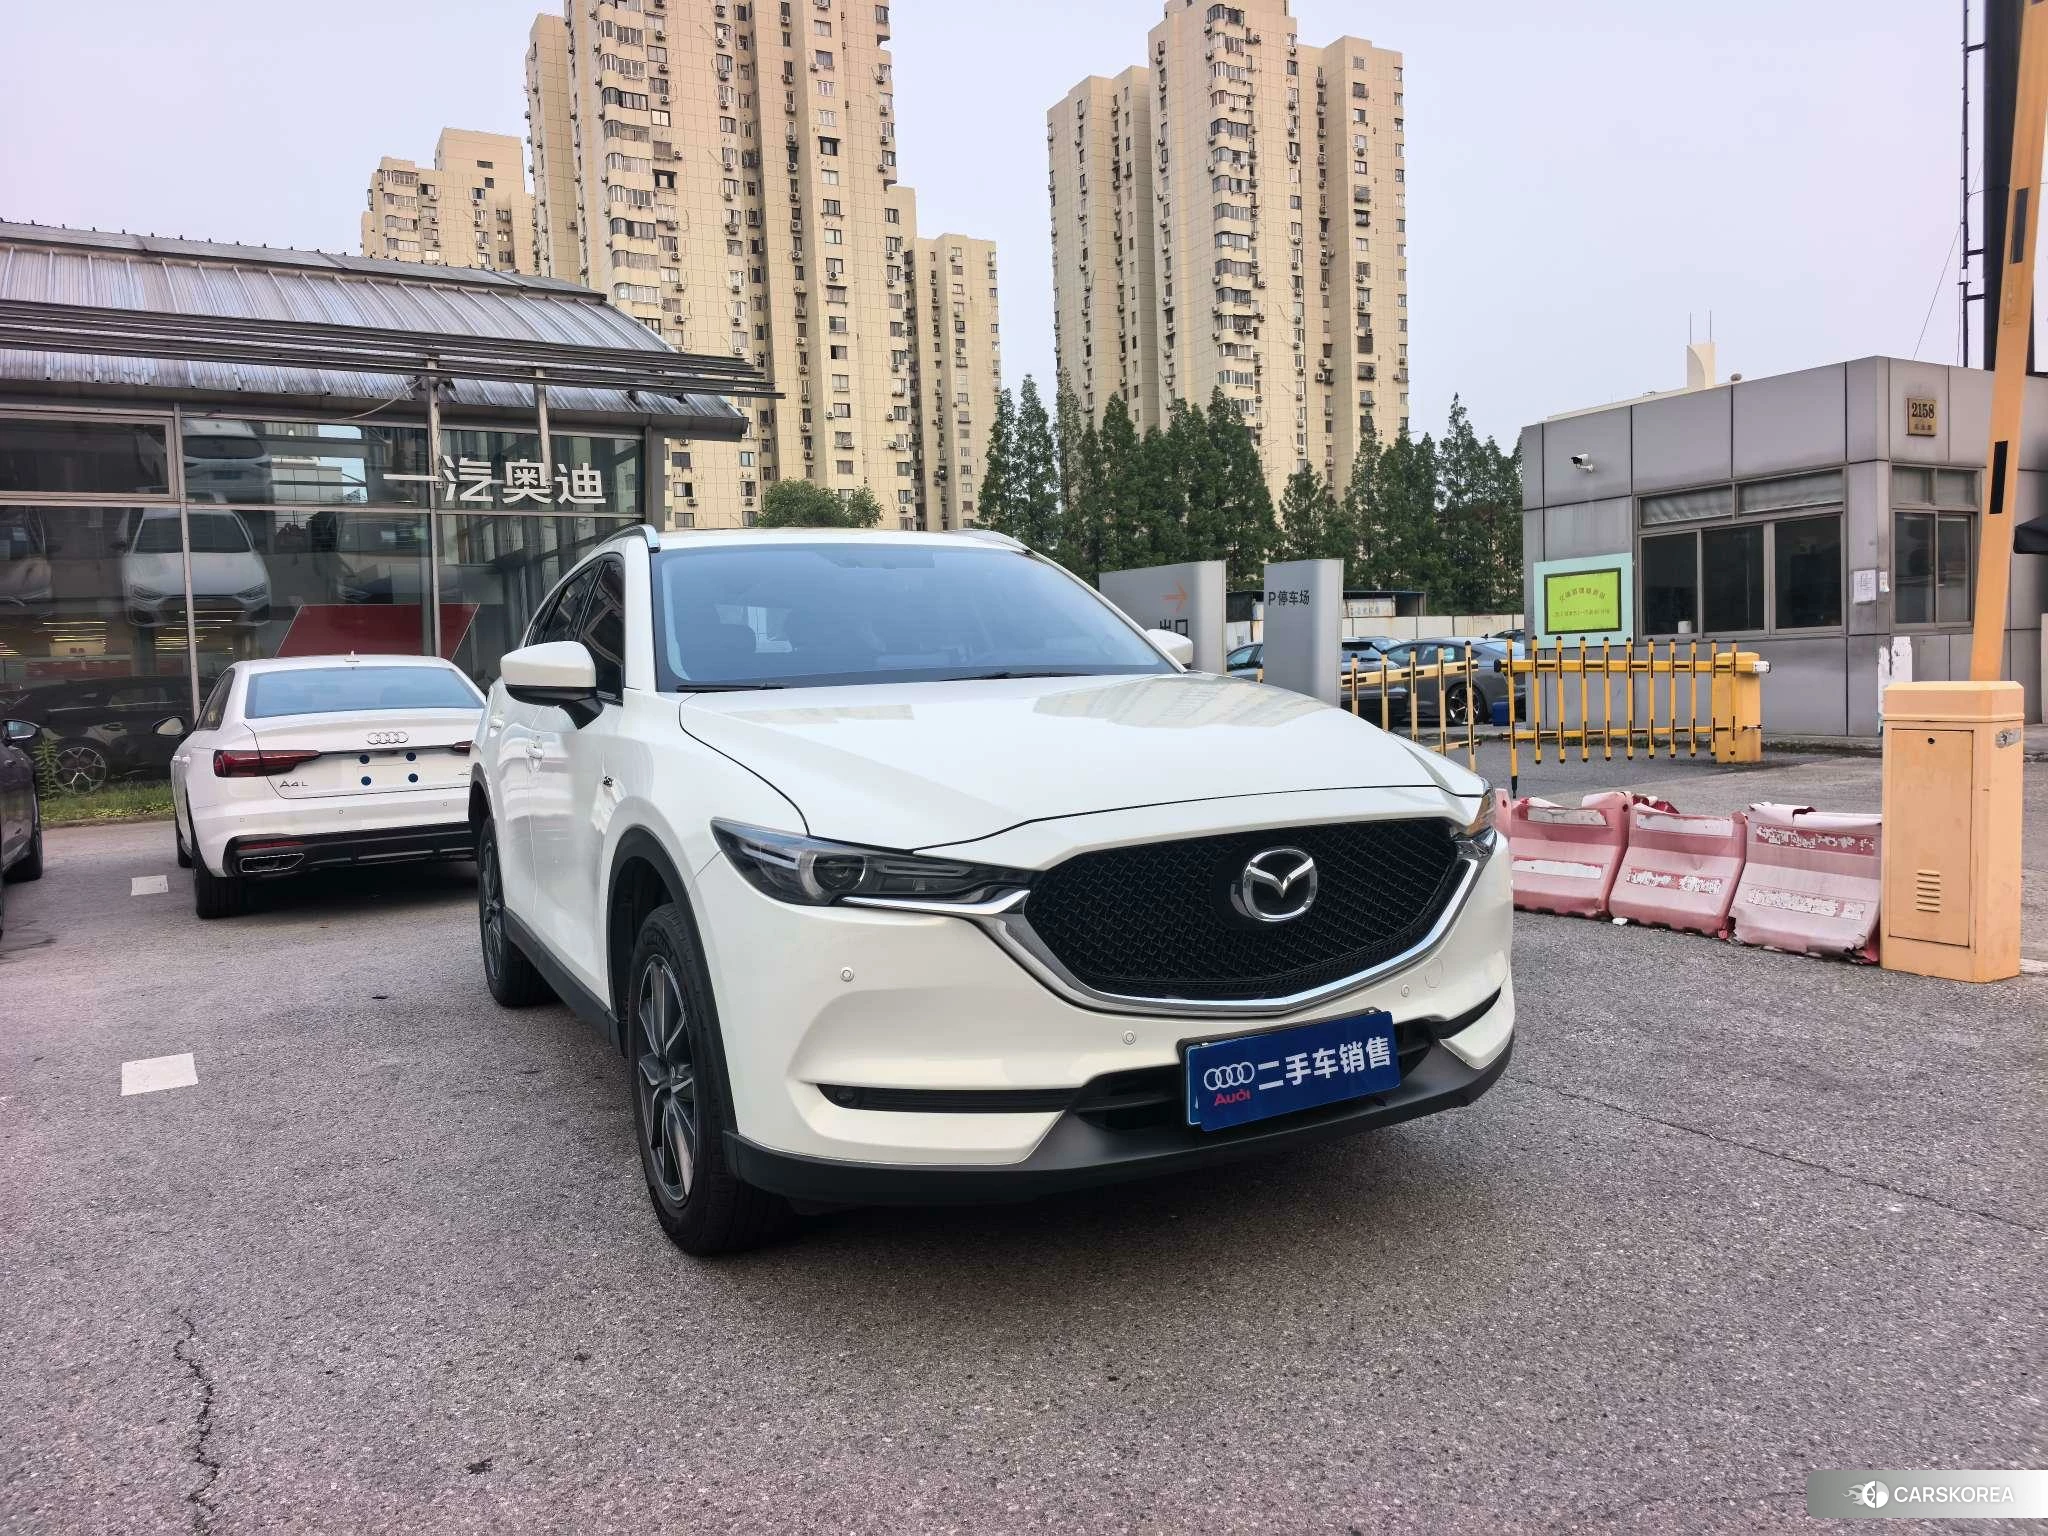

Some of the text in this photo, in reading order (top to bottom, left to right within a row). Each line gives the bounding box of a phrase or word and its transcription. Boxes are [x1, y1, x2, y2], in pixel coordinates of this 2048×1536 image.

[1912, 402, 1935, 419] 2158
[383, 455, 607, 504] 一汽奥迪
[280, 780, 309, 788] A4L
[1258, 1036, 1391, 1090] 二手车销售
[1214, 1089, 1251, 1107] Audi
